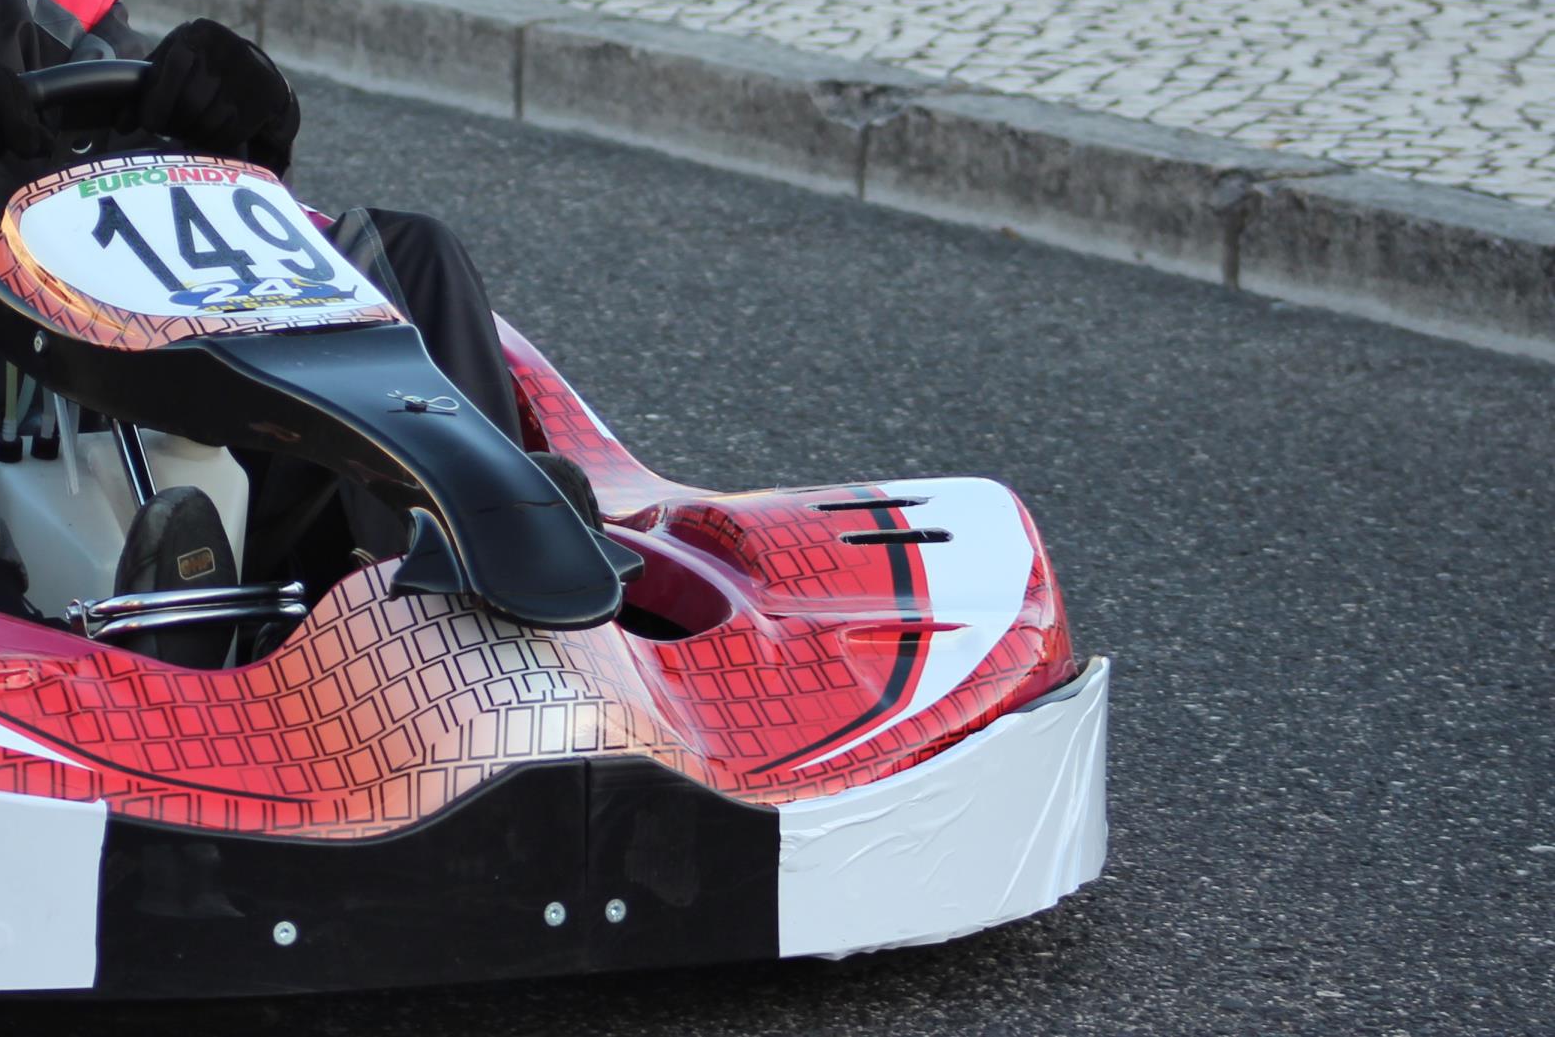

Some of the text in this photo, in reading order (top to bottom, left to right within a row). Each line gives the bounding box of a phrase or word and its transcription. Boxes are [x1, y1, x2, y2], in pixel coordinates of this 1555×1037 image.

[78, 167, 245, 199] EUROINDY
[91, 186, 336, 292] 149
[189, 278, 303, 304] 24
